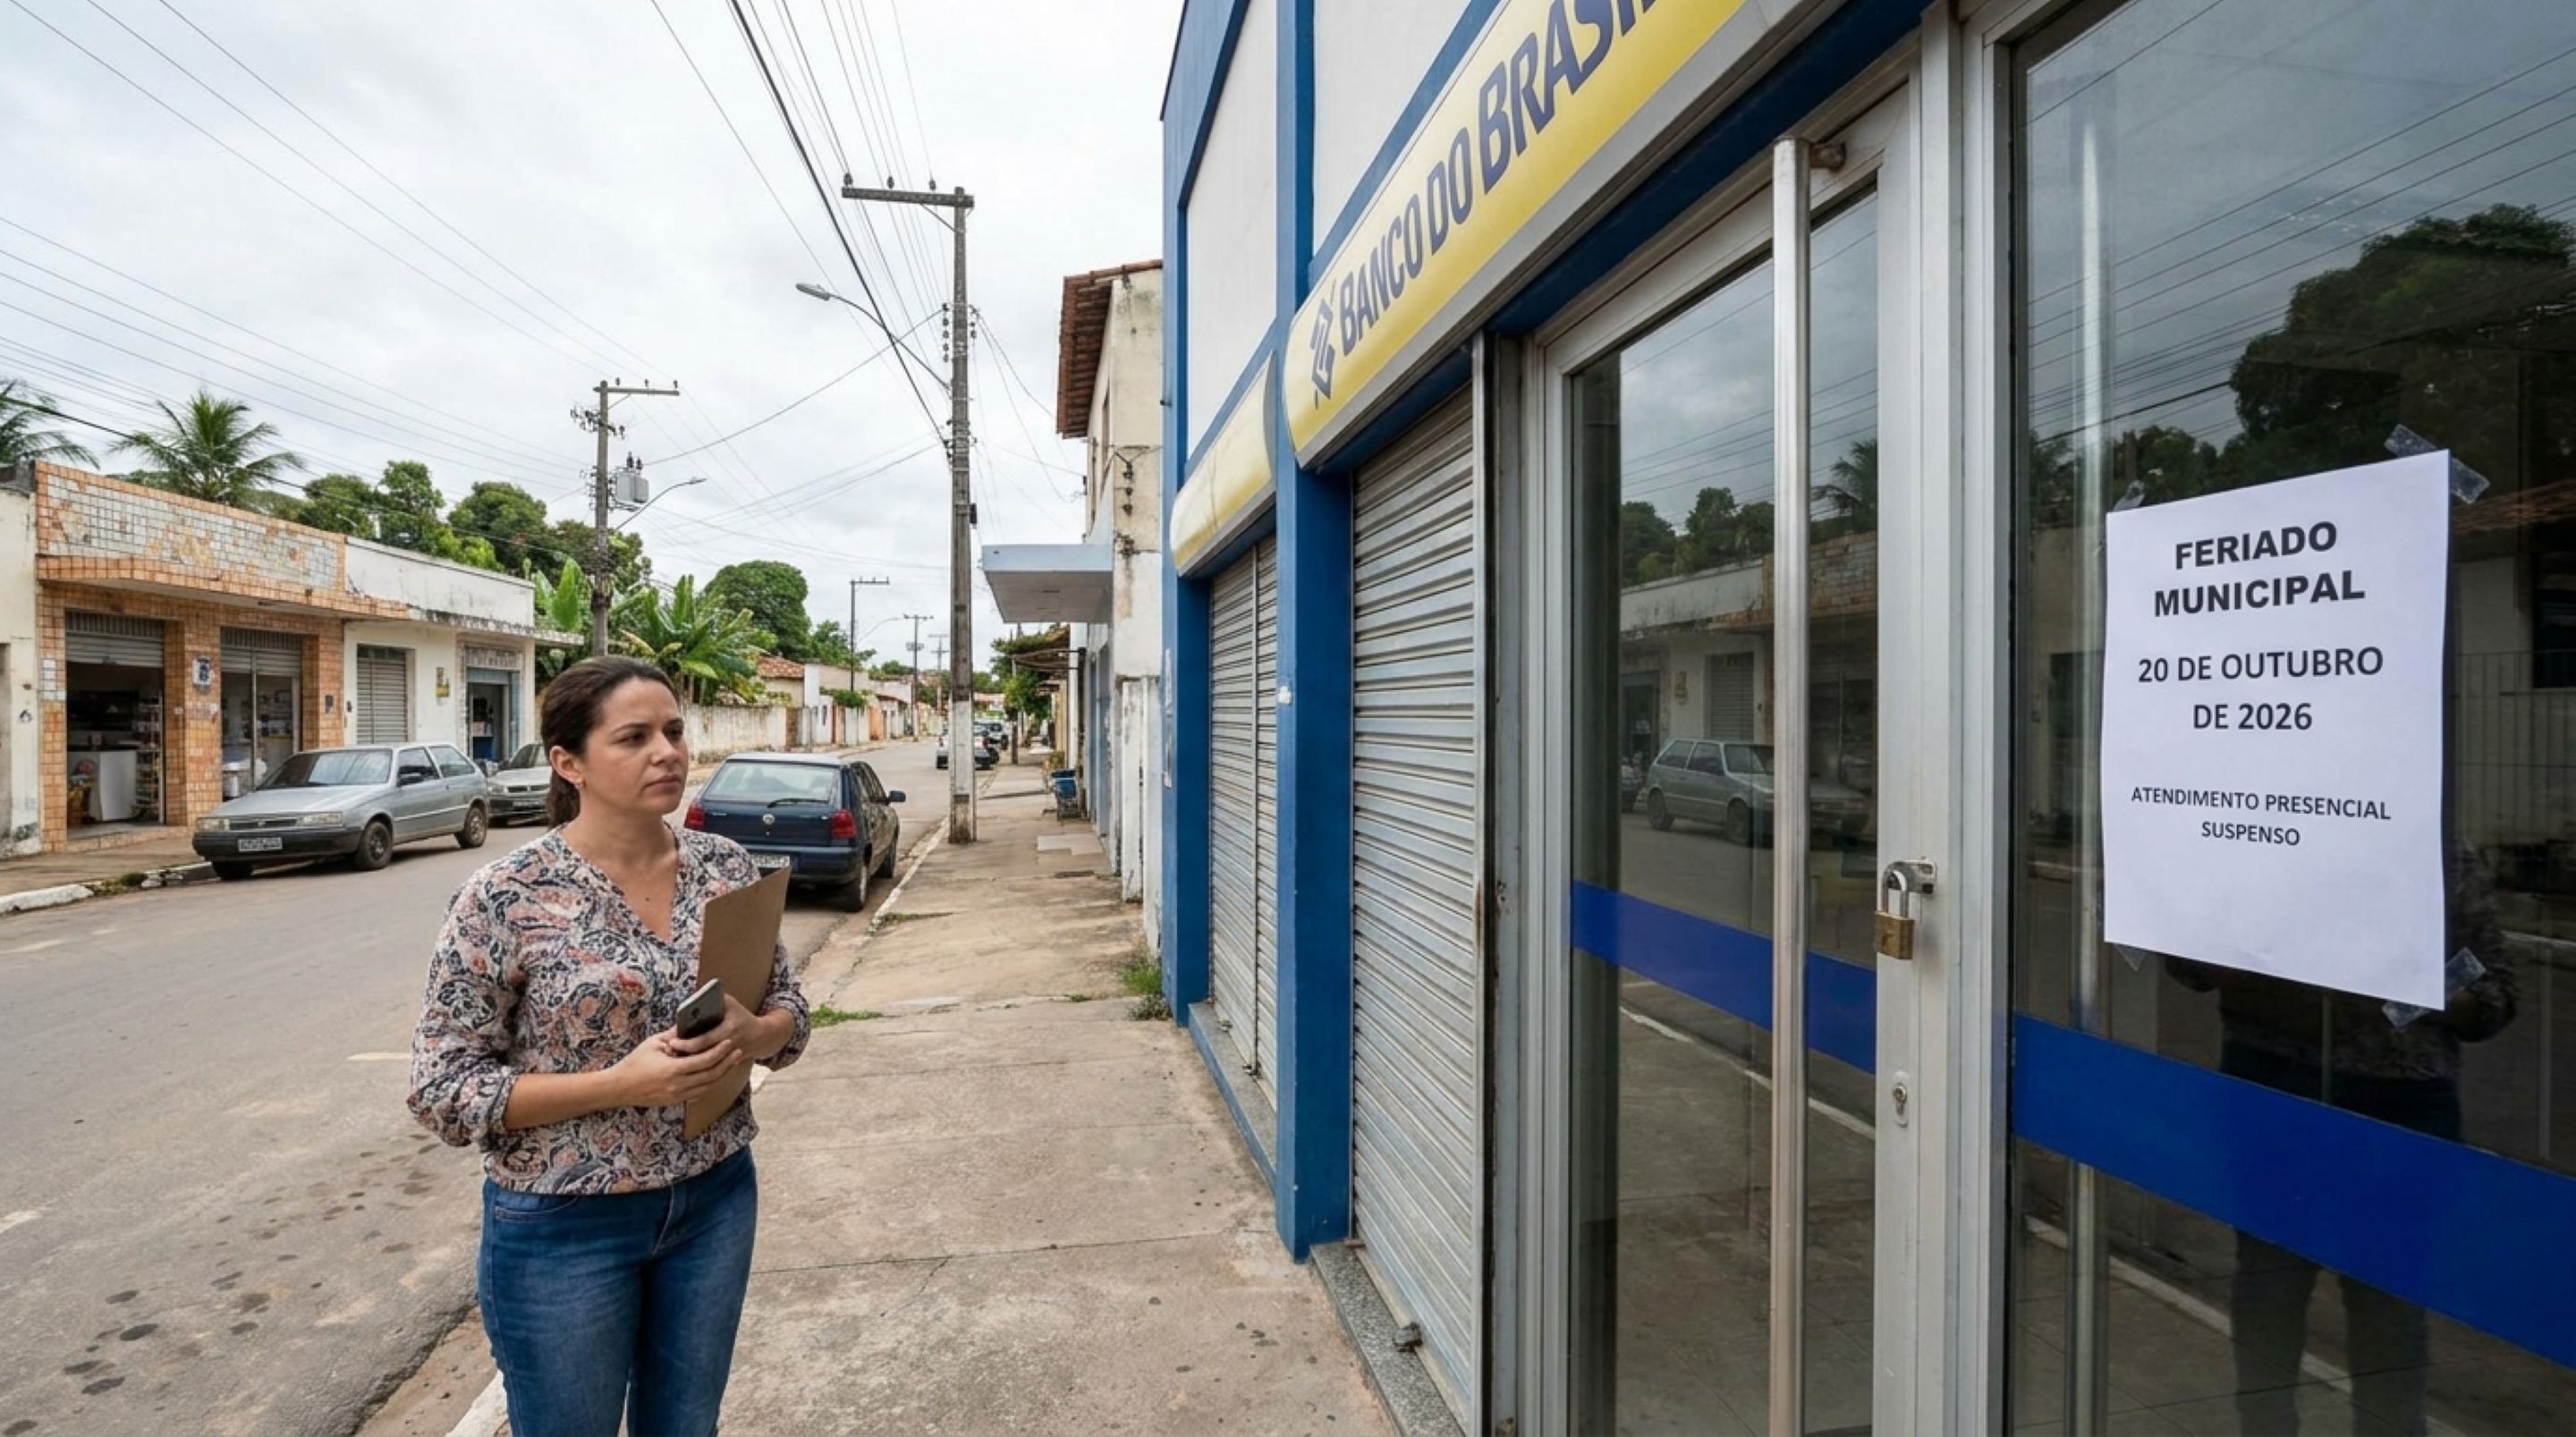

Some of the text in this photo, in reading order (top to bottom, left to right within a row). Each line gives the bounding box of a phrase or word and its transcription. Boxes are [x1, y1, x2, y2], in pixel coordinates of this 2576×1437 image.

[1339, 0, 1656, 357] BANCO DO BRAS
[2175, 520, 2337, 571] FERIADO
[2155, 570, 2366, 618] MUNICIPAL
[2138, 646, 2384, 683] 20 DE OUTUBRO
[2193, 702, 2313, 731] DE 2026
[2131, 786, 2392, 821] ATENDIMENTO PRESENCIAL
[2201, 820, 2301, 846] SUSPENSO
